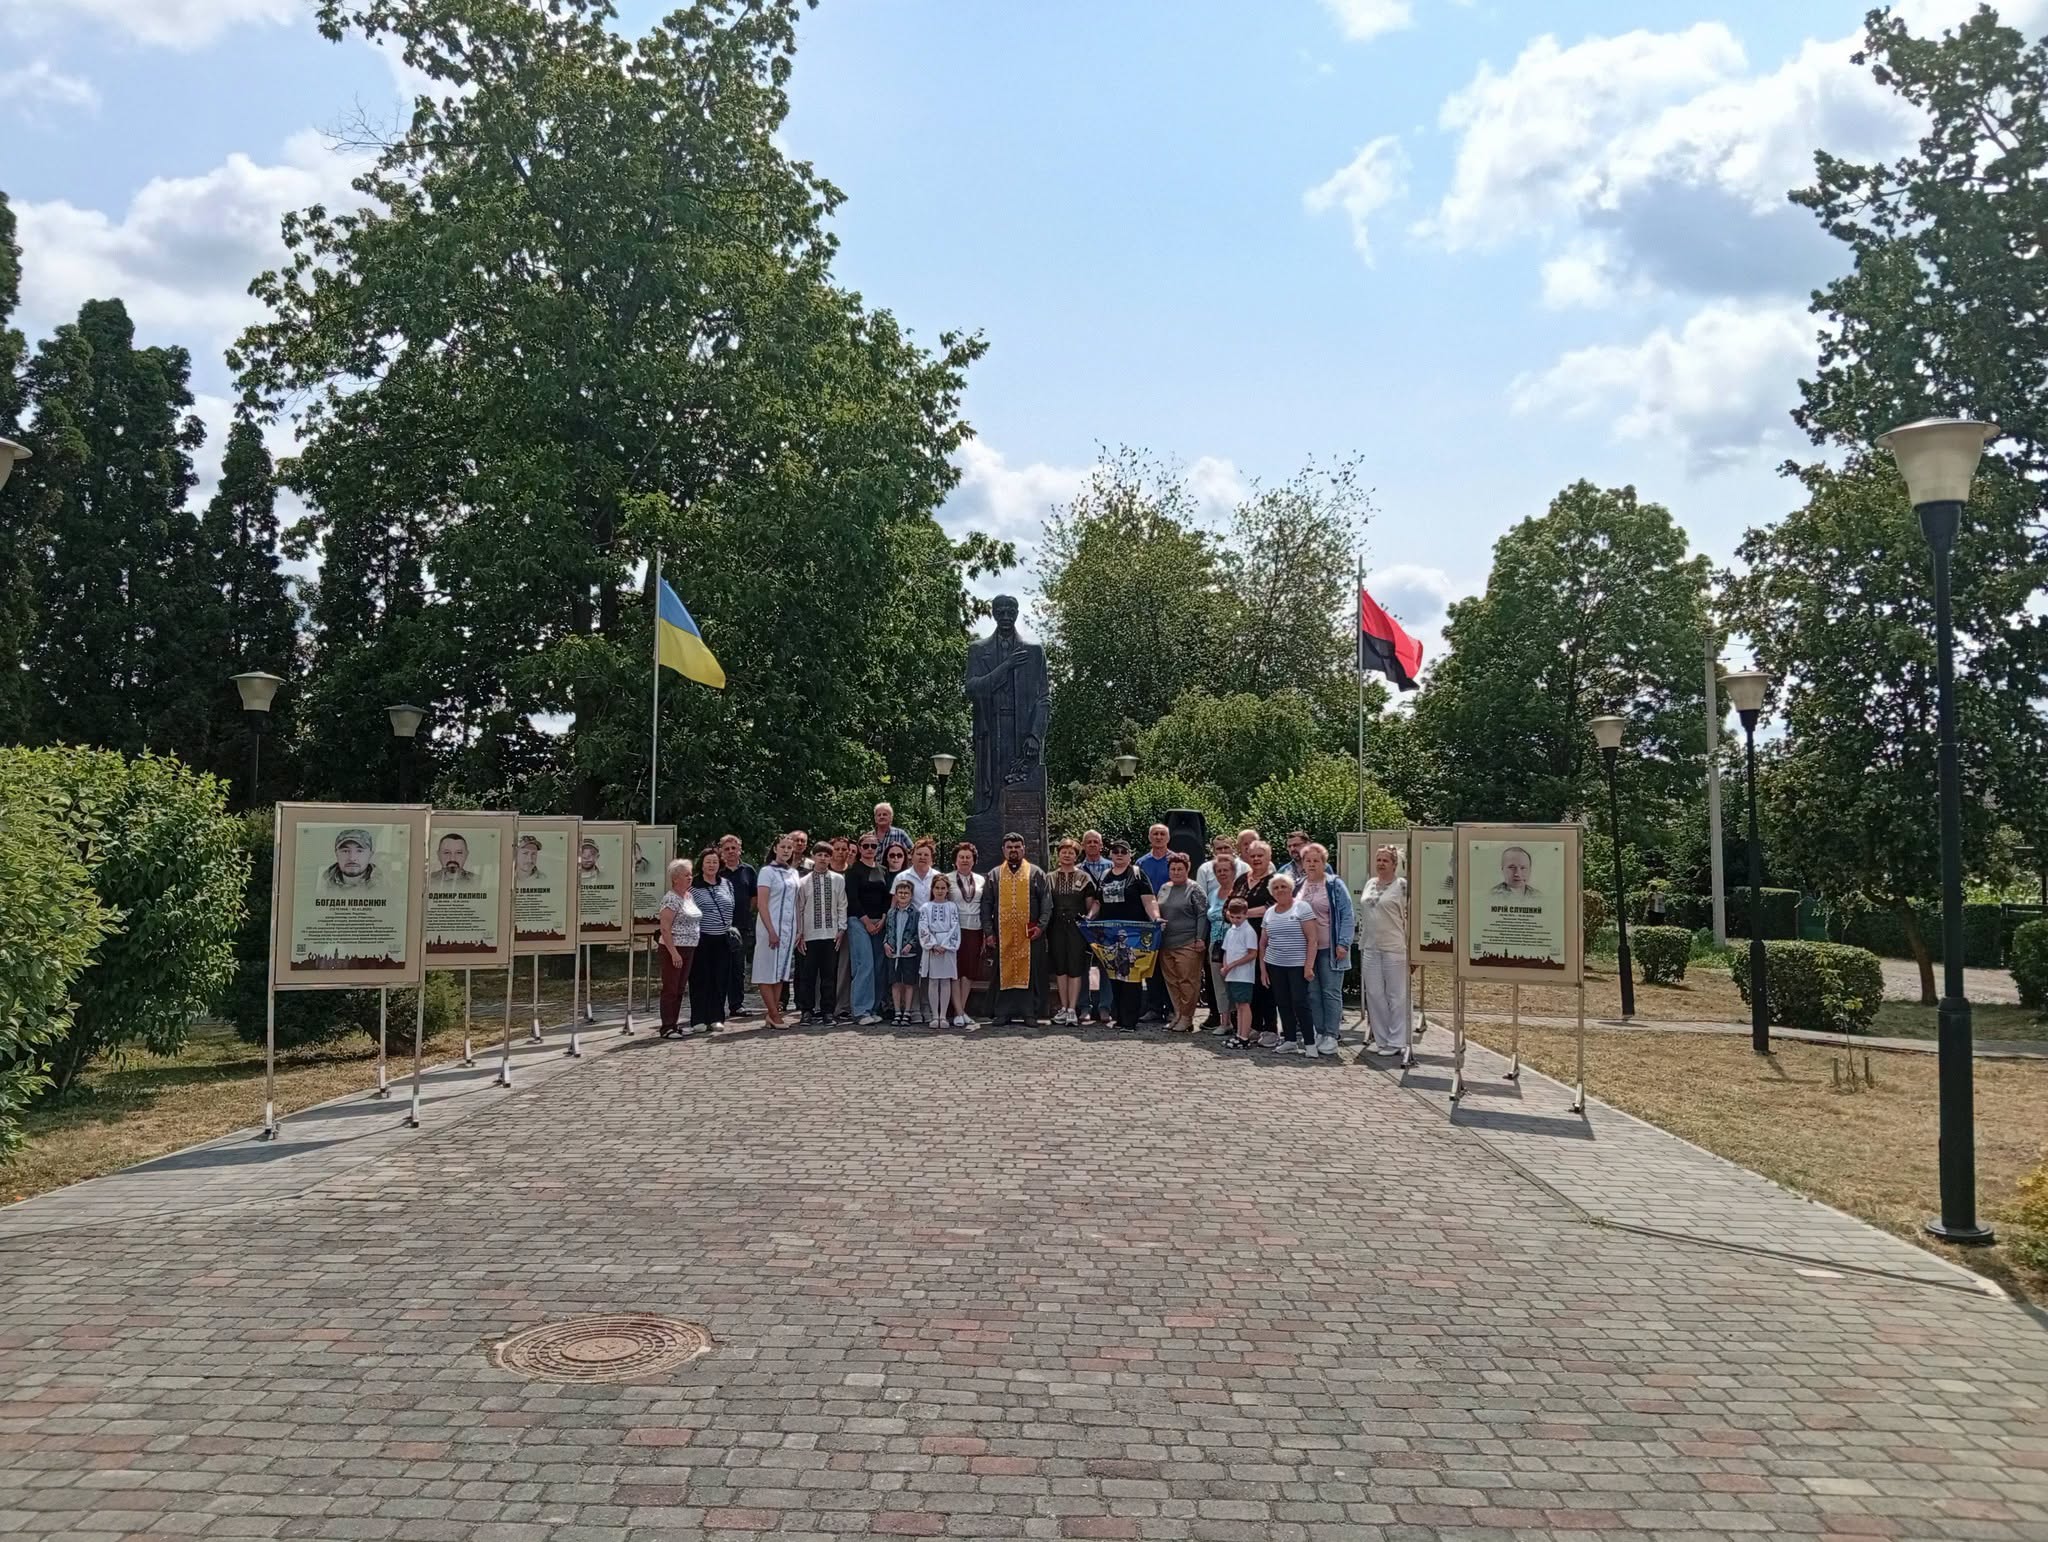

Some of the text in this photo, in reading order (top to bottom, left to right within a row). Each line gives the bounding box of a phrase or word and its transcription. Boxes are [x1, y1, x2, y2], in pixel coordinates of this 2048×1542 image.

[428, 892, 457, 900] ОДИМИР
[315, 899, 387, 907] БОГДАН КВАСНЮК
[1509, 906, 1542, 914] СЛУШНИЙ
